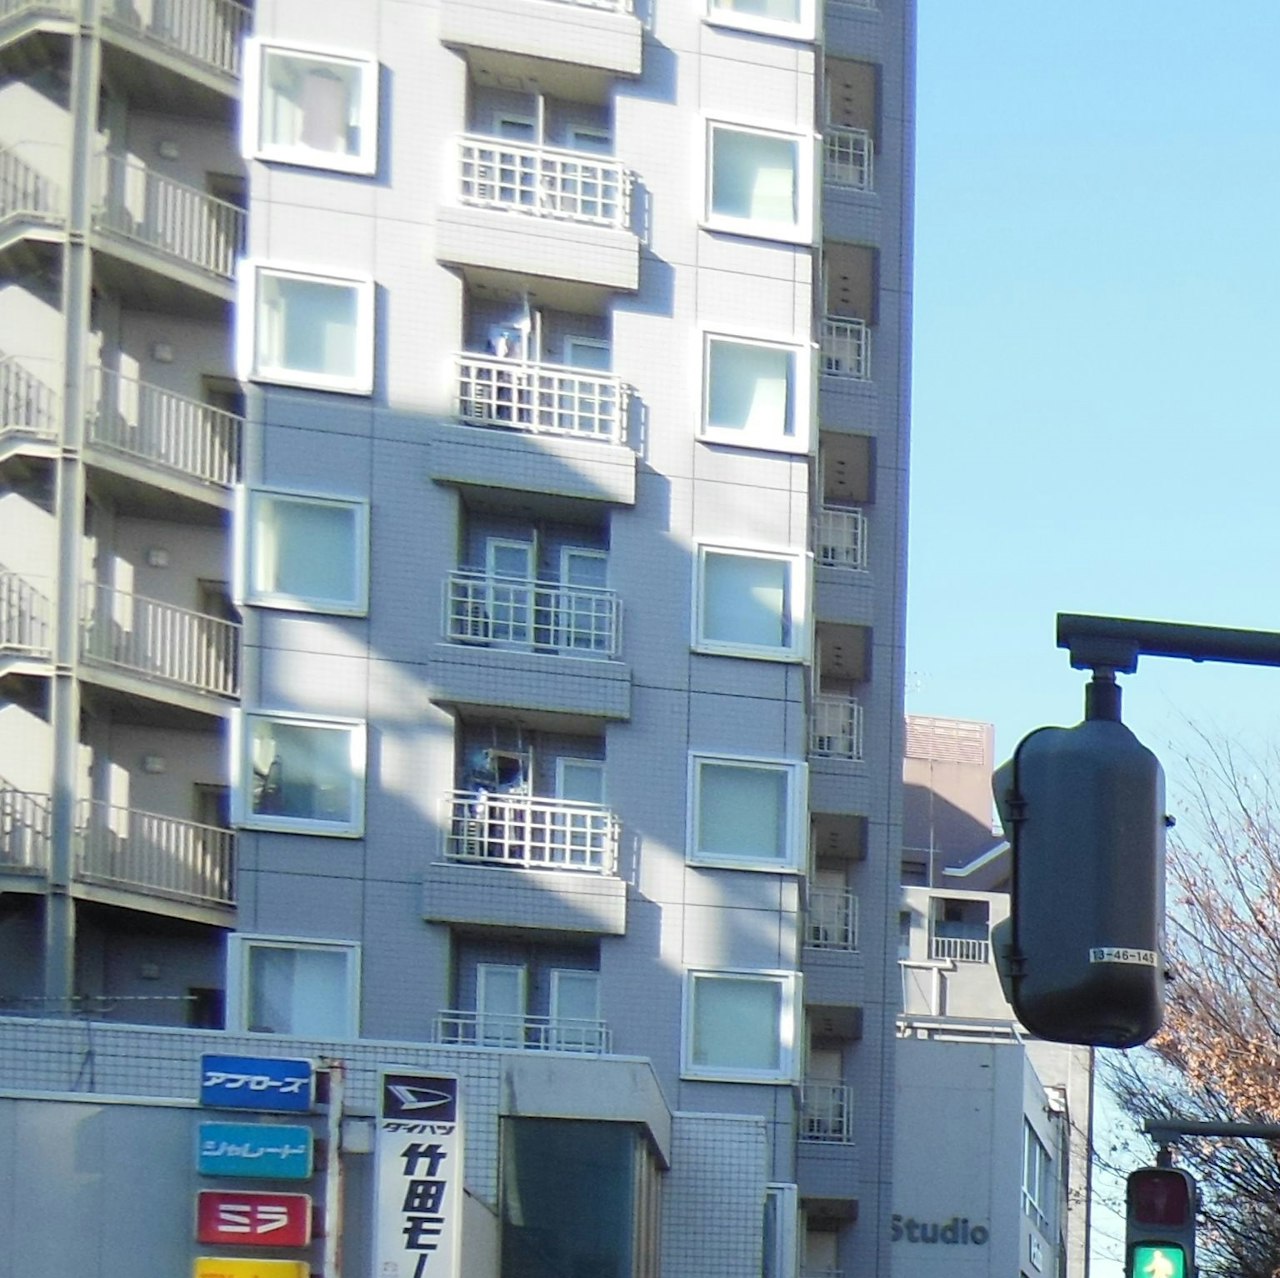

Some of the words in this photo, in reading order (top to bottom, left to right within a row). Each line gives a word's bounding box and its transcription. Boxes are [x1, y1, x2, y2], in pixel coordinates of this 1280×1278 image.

[202, 1070, 310, 1094] アプローズ
[382, 1121, 456, 1136] ダイハツ
[216, 1203, 289, 1235] ミラ
